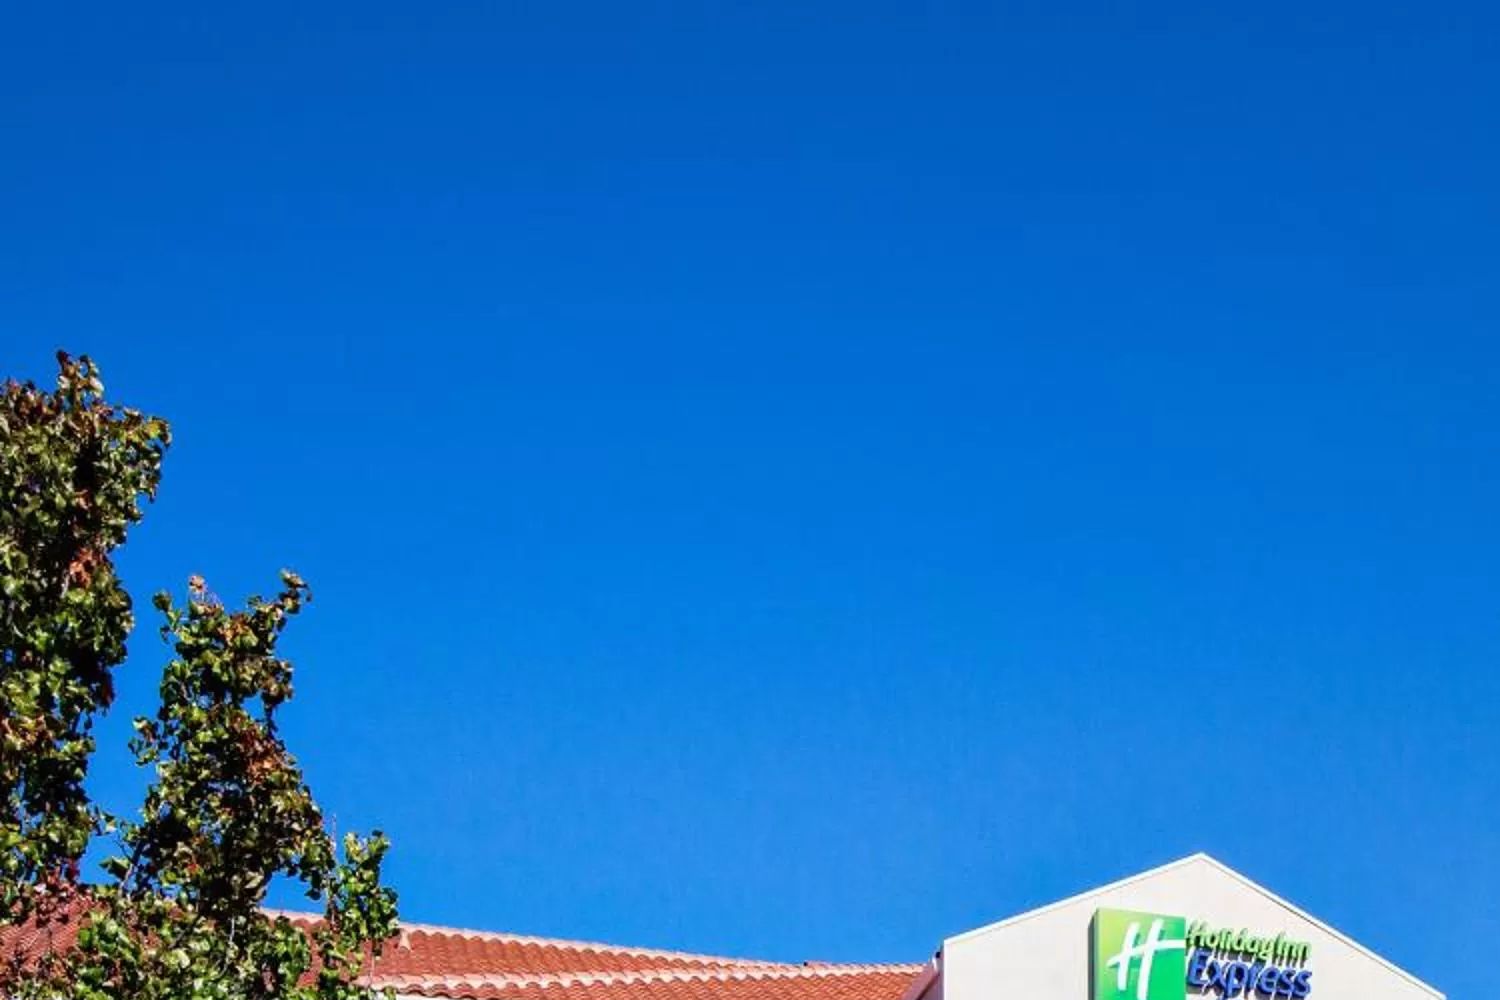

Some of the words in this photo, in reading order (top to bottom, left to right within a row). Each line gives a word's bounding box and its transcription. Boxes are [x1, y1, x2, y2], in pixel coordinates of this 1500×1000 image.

[1186, 921, 1273, 960] Holiday
[1271, 931, 1312, 962] Inn
[1187, 948, 1312, 999] Express
